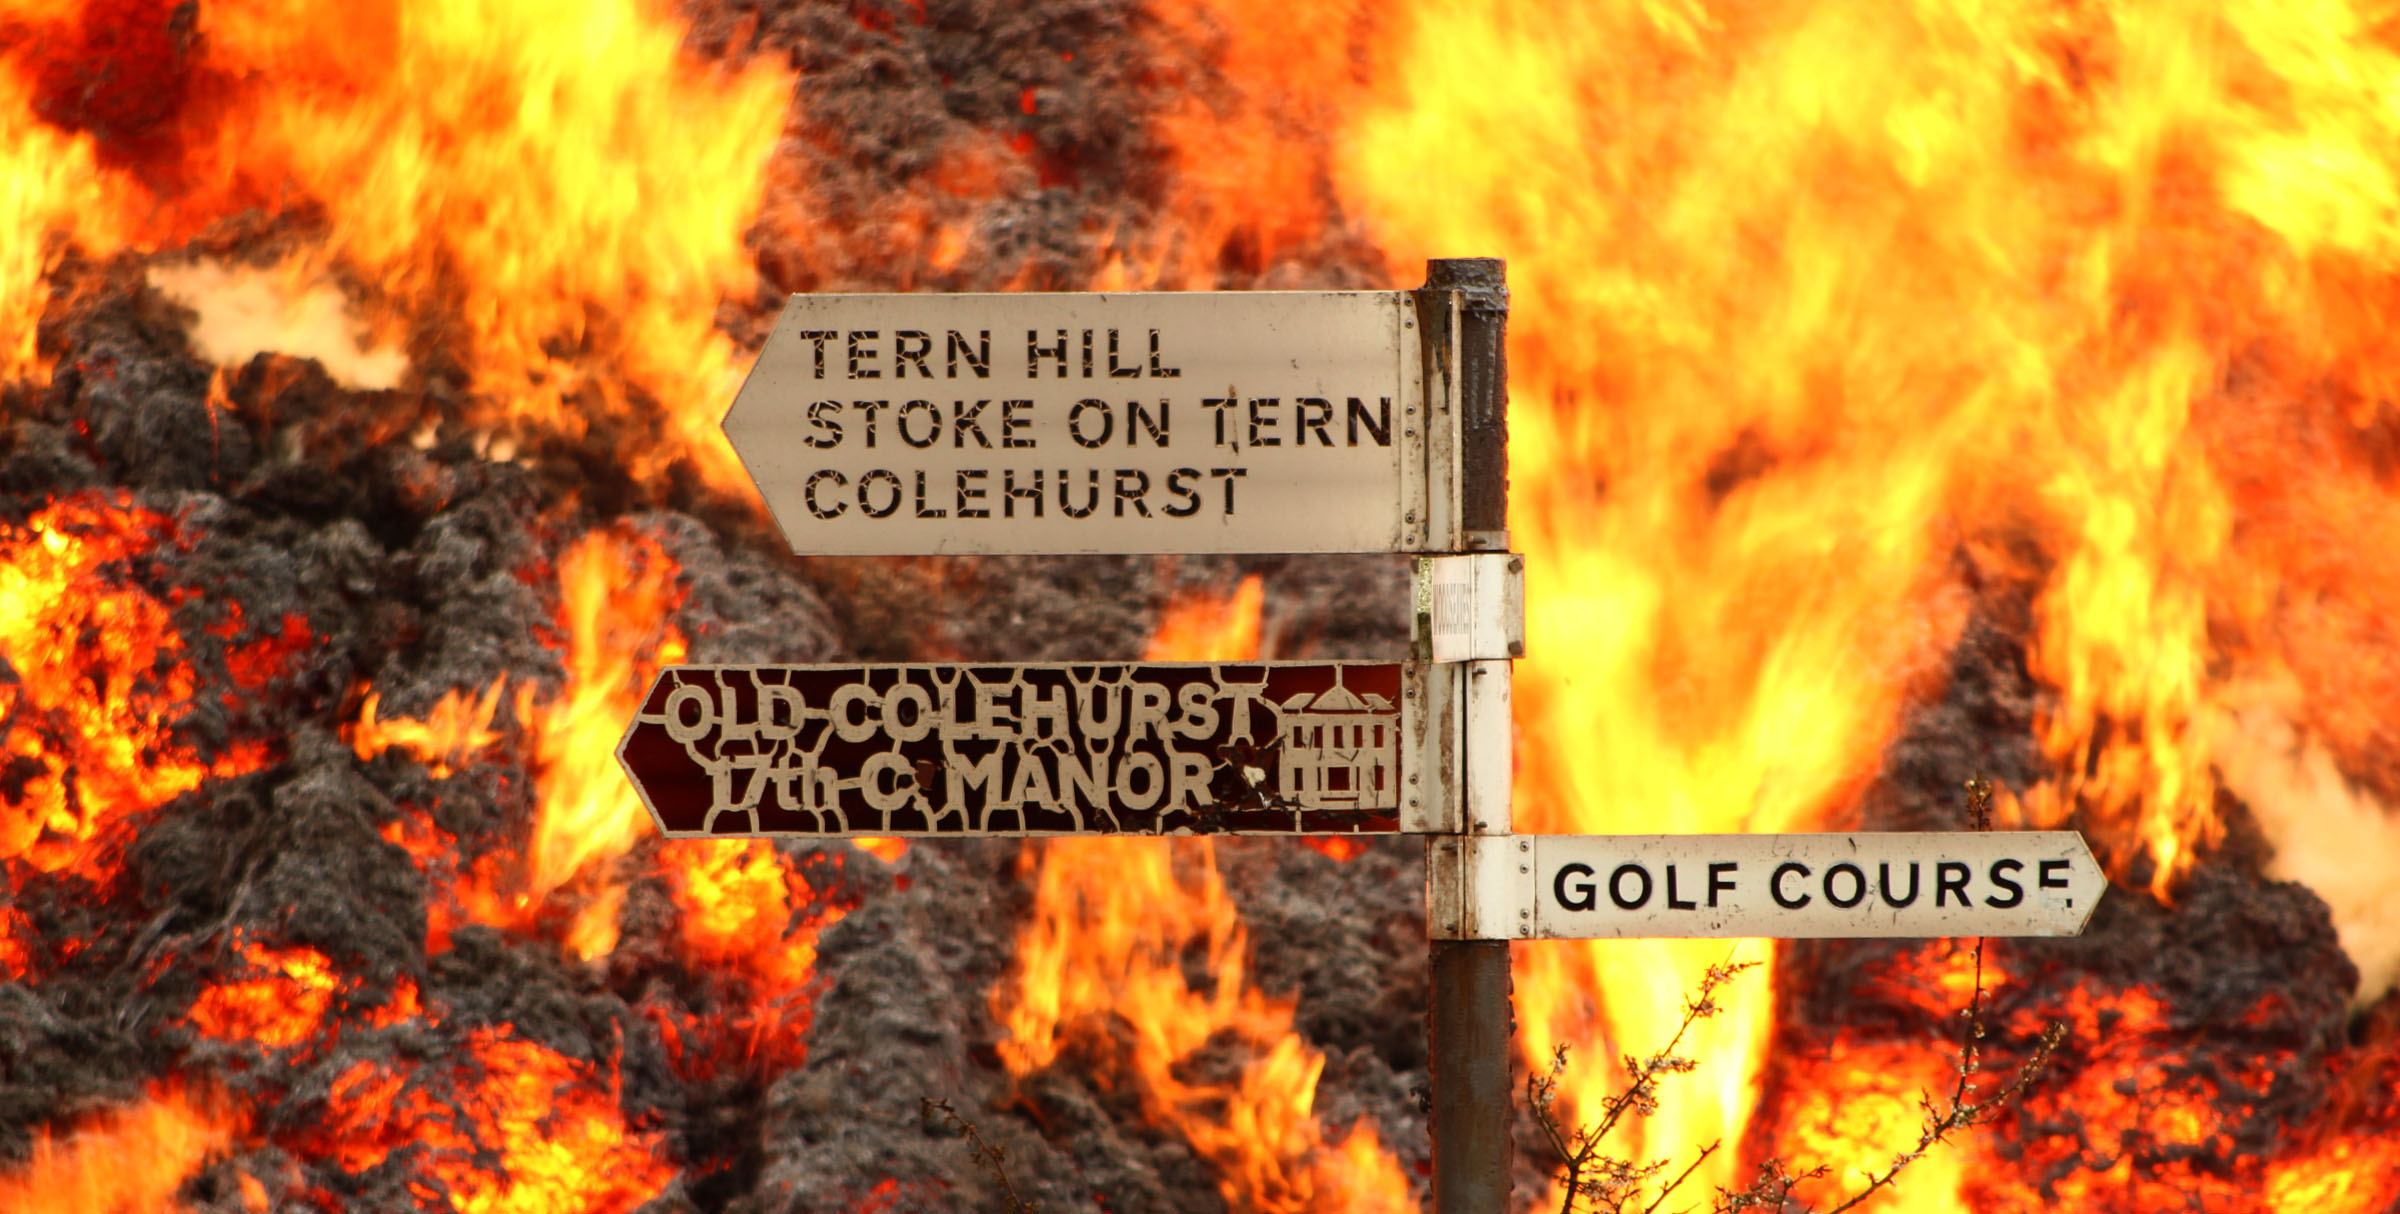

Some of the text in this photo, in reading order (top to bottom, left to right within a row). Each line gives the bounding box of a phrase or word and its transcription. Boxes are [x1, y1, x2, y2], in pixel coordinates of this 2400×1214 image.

[800, 328, 1181, 379] TERN HILL
[803, 397, 1392, 449] STOKE ON TERN
[804, 467, 1247, 519] COLEHURST
[665, 683, 1264, 742] OLD COLEHURST
[712, 752, 833, 811] 17th
[946, 750, 1214, 809] MANOR
[1553, 862, 1739, 911] GOLF
